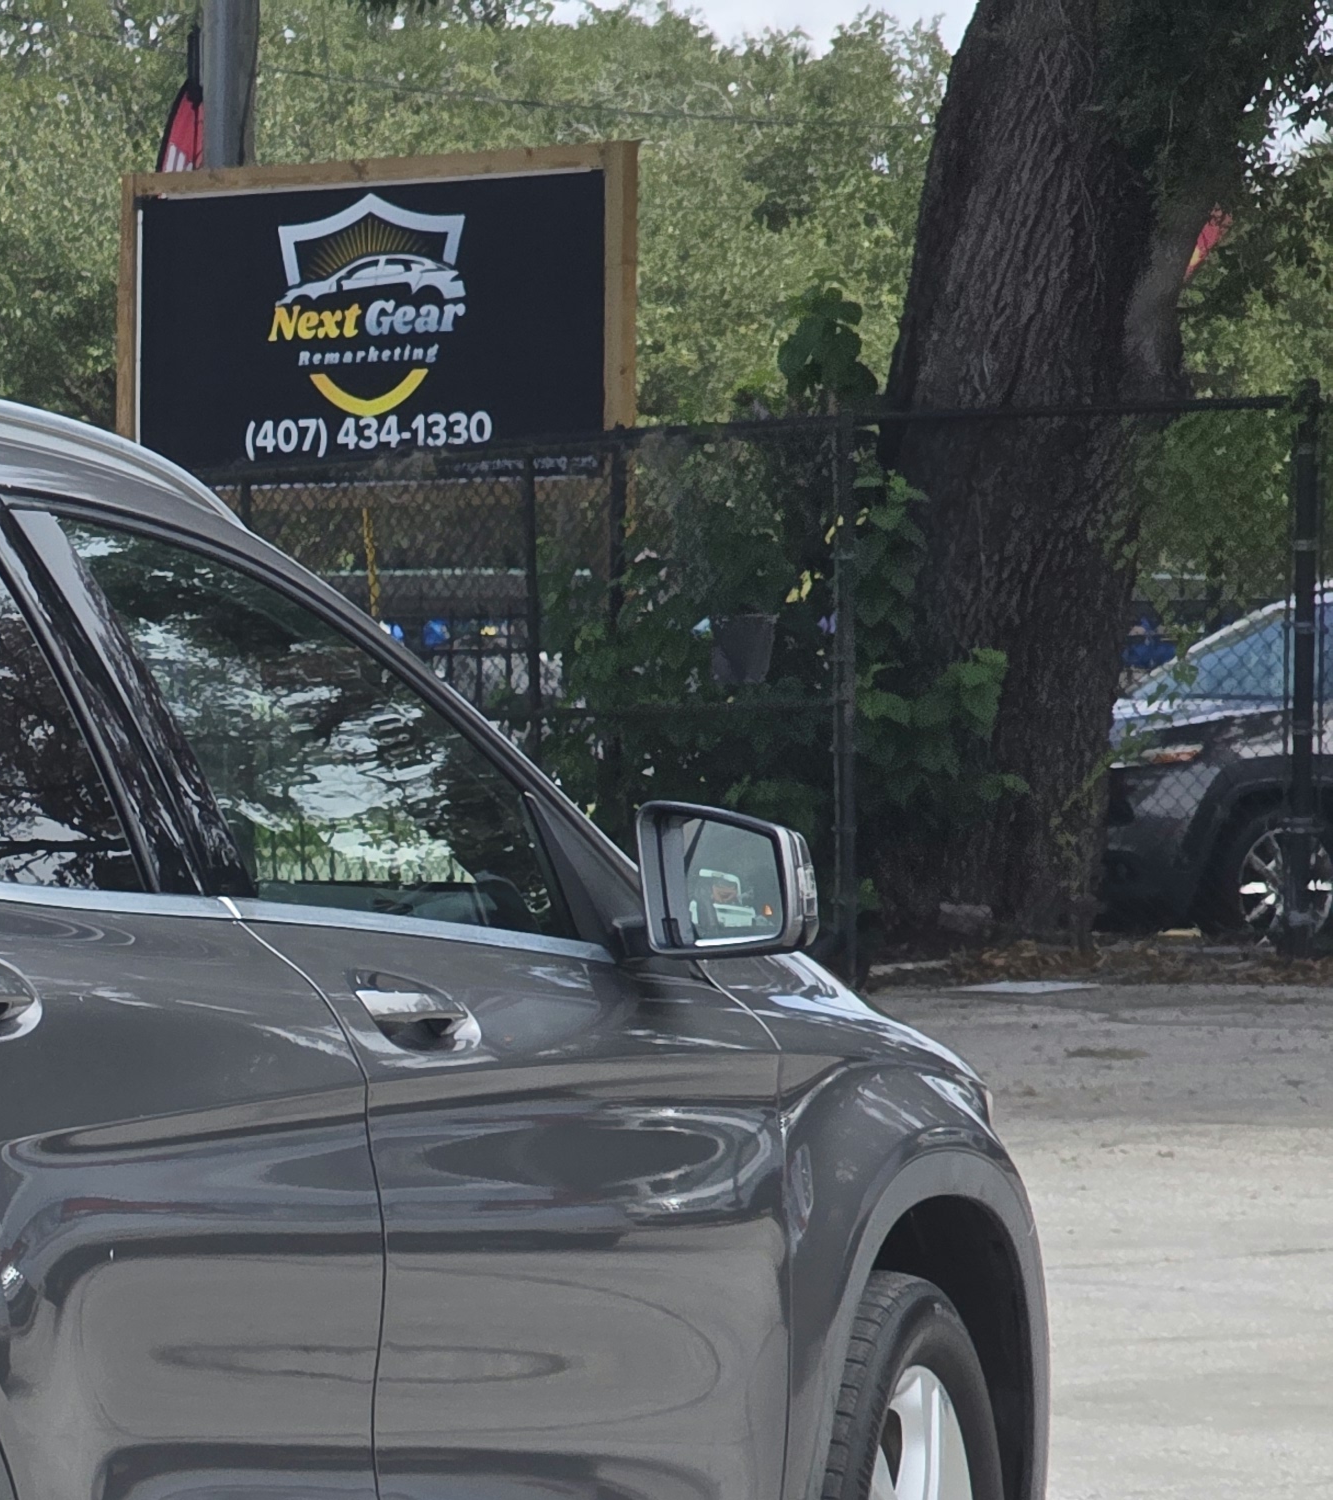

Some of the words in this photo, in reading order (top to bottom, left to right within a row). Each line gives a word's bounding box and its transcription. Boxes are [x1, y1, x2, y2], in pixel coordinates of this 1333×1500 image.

[268, 304, 361, 342] Next
[365, 299, 465, 336] Gear
[298, 344, 439, 366] Remarketing
[245, 417, 327, 460] (407)
[337, 411, 492, 449] 434-1330
